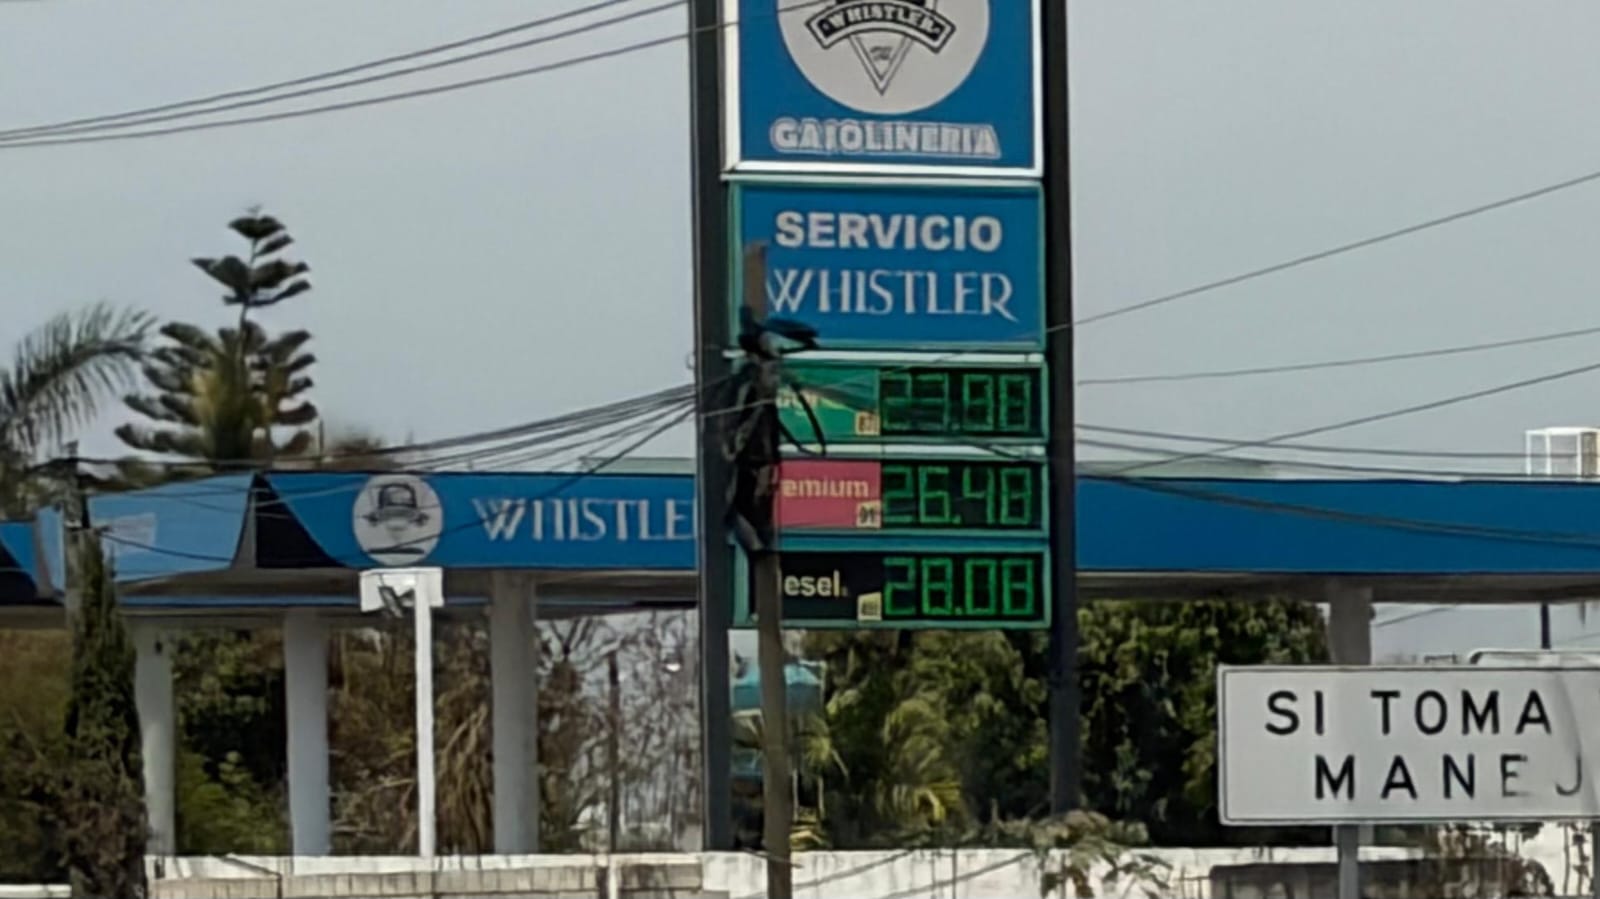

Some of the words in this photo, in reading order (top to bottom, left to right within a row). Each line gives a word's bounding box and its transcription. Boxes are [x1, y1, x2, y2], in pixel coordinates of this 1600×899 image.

[827, 5, 936, 33] WHISTLER
[775, 211, 1002, 252] SERVICIO
[766, 268, 1018, 322] WHISTLER
[780, 475, 869, 497] emium
[883, 465, 1031, 524] 26.48
[471, 498, 697, 541] WHISTLE
[884, 557, 1033, 615] 28.08
[1265, 689, 1324, 735] SI
[1370, 689, 1551, 735] TOMA
[1315, 753, 1582, 800] MANEJ
